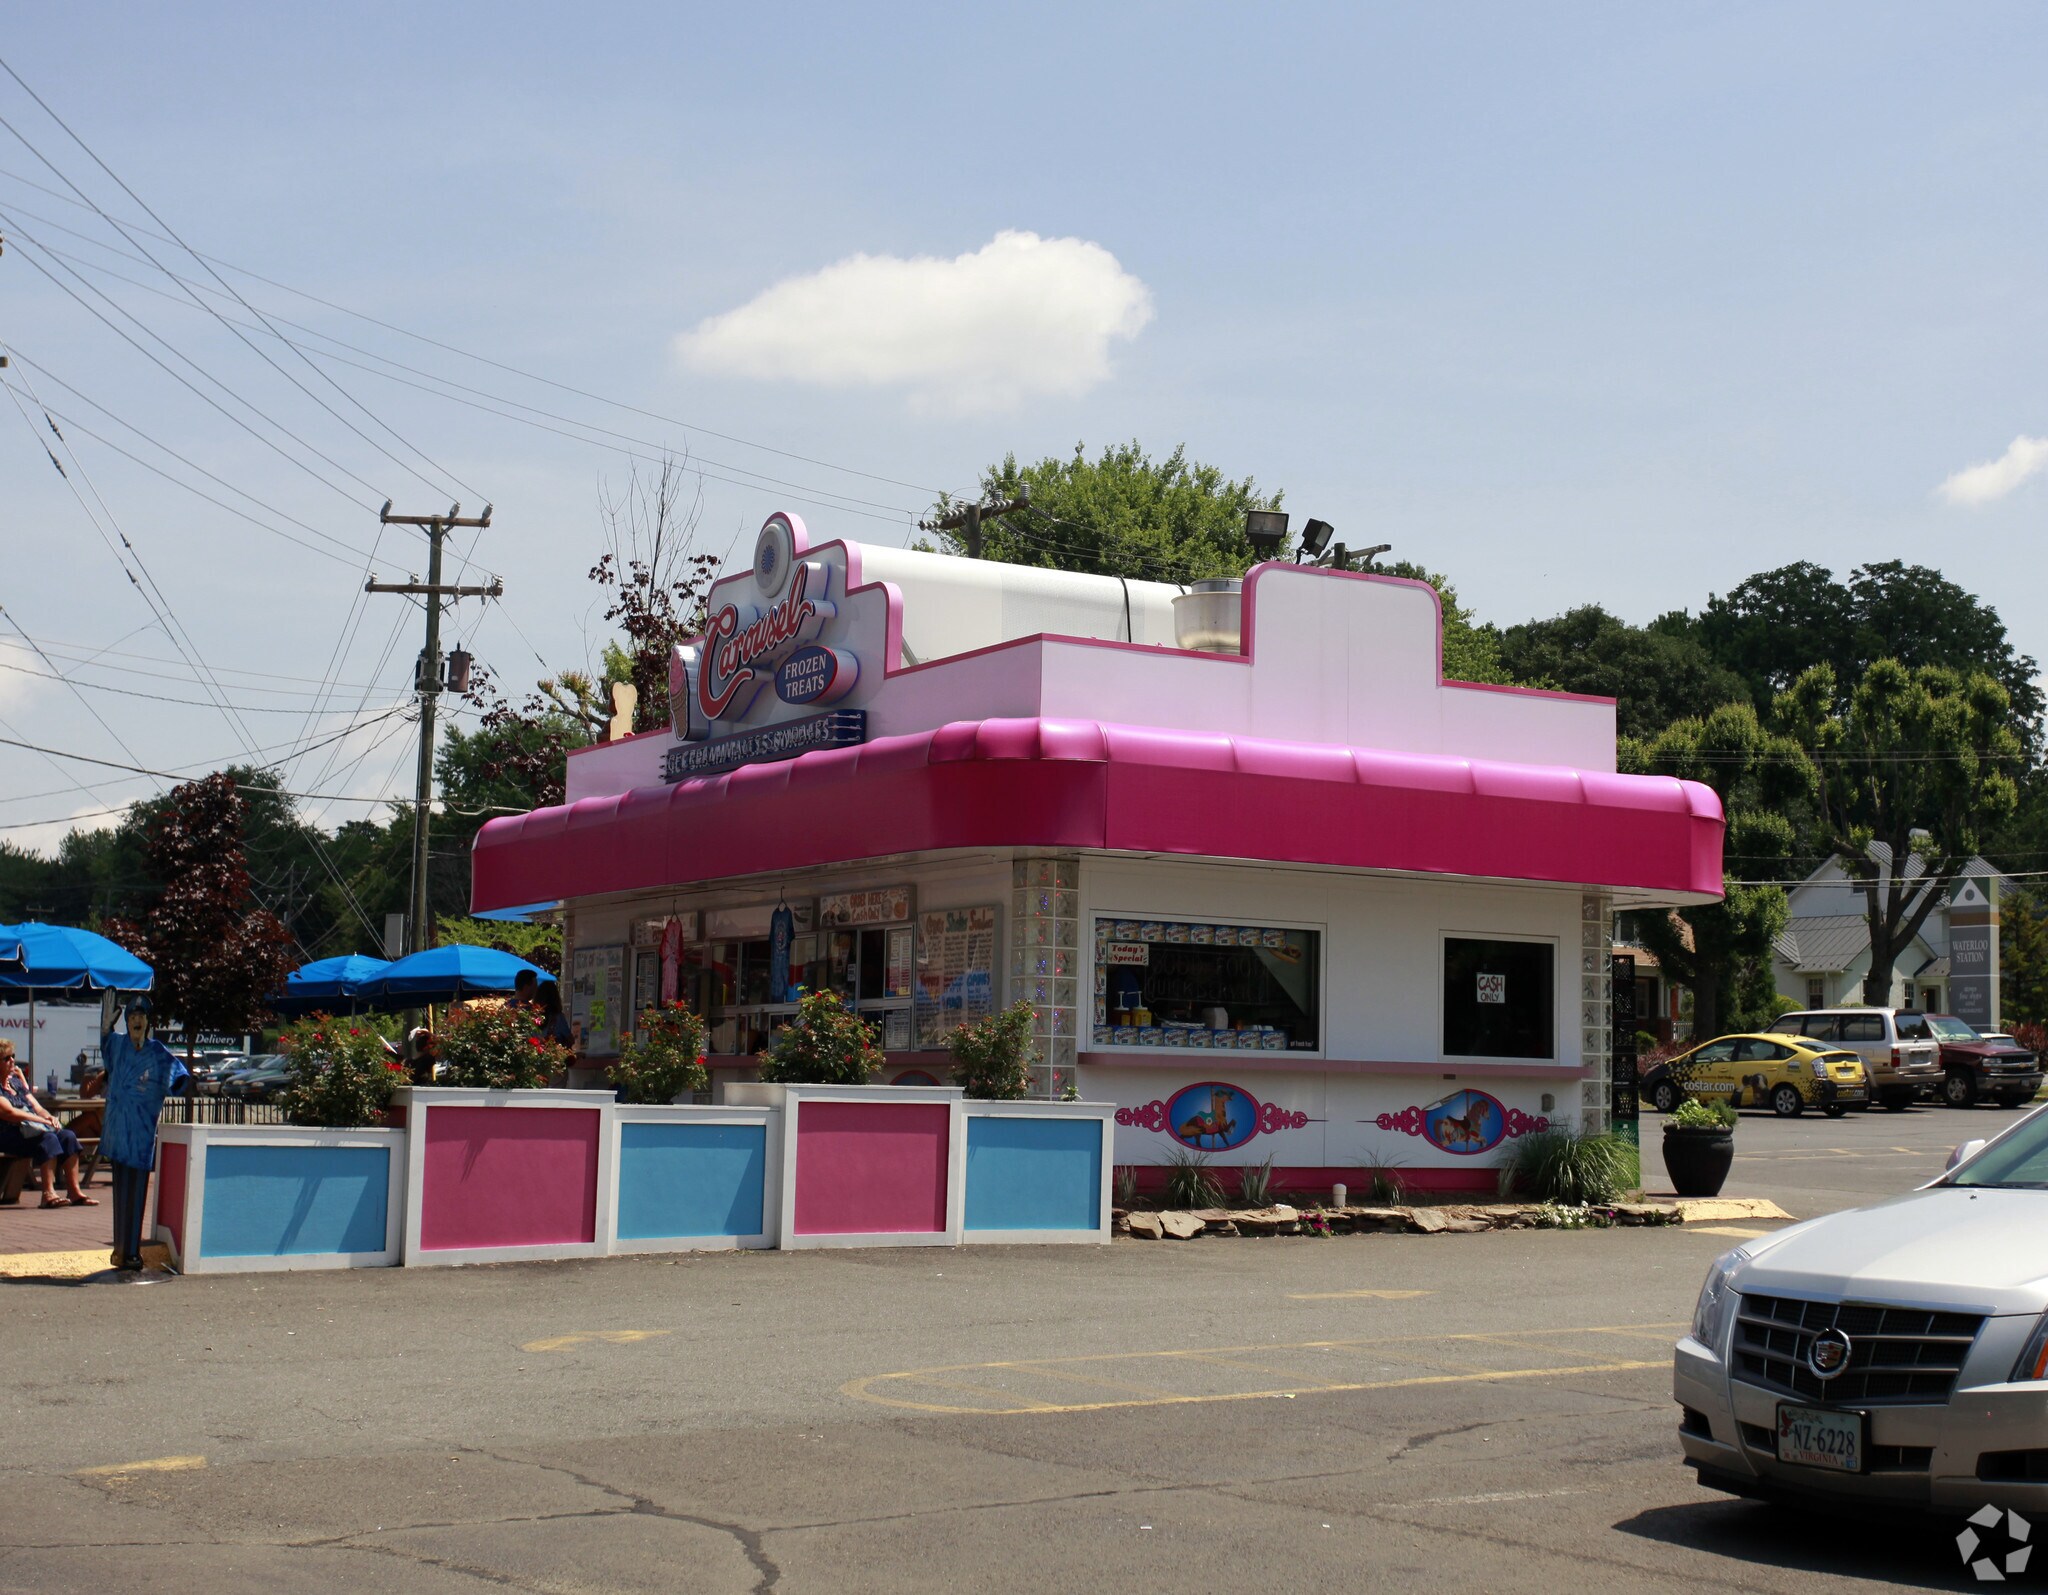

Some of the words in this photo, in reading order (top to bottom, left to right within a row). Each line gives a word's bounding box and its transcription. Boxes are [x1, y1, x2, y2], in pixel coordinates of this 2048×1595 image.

[698, 561, 815, 720] Carousel
[785, 654, 827, 680] FROZEN
[786, 675, 825, 698] TREATS
[1111, 944, 1145, 955] Today's
[1952, 939, 1989, 951] WATERLOO
[1112, 954, 1144, 963] Special
[1956, 951, 1984, 963] STATION
[1480, 992, 1499, 1002] ONLY
[195, 1033, 236, 1046] Delivery
[1683, 1080, 1735, 1092] costar.com
[1836, 1088, 1865, 1098] costar.com
[1799, 1450, 1839, 1465] VIRGINIA
